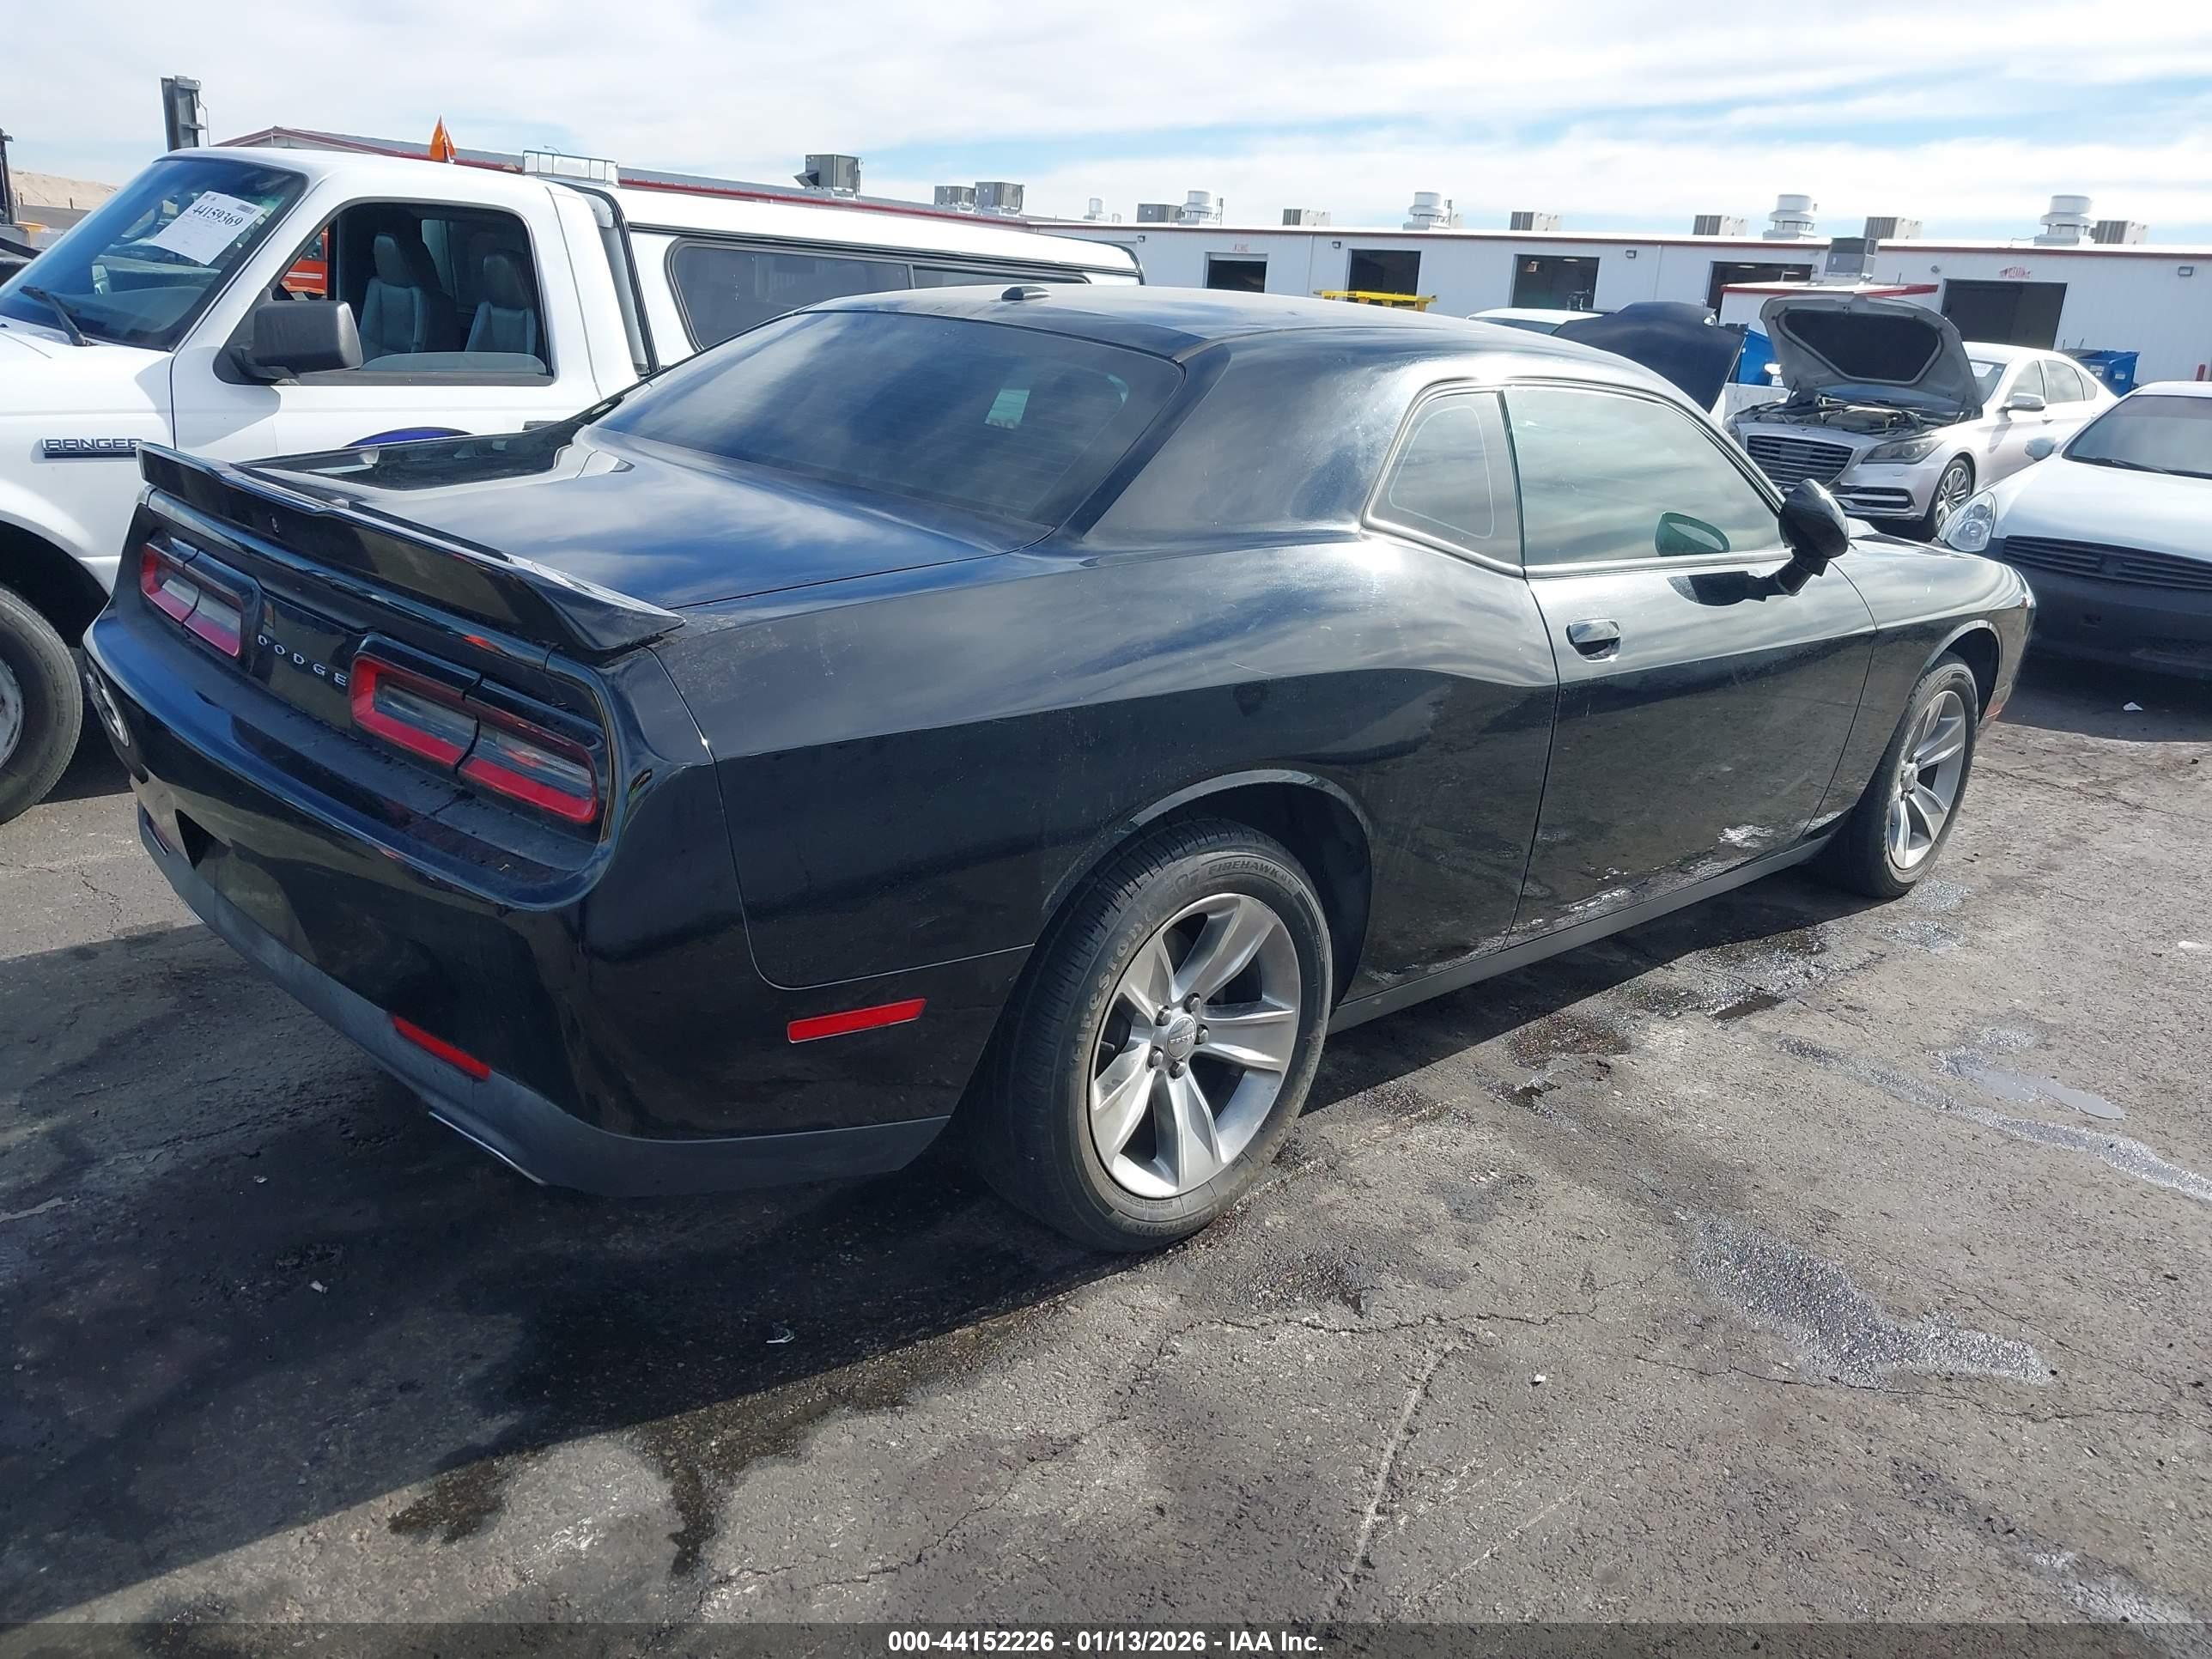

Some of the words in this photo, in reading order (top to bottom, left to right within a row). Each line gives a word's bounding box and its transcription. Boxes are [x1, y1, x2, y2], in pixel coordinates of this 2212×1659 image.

[192, 204, 244, 228] 44159369
[258, 634, 348, 686] DODGE
[1207, 860, 1279, 878] FIREHAWK
